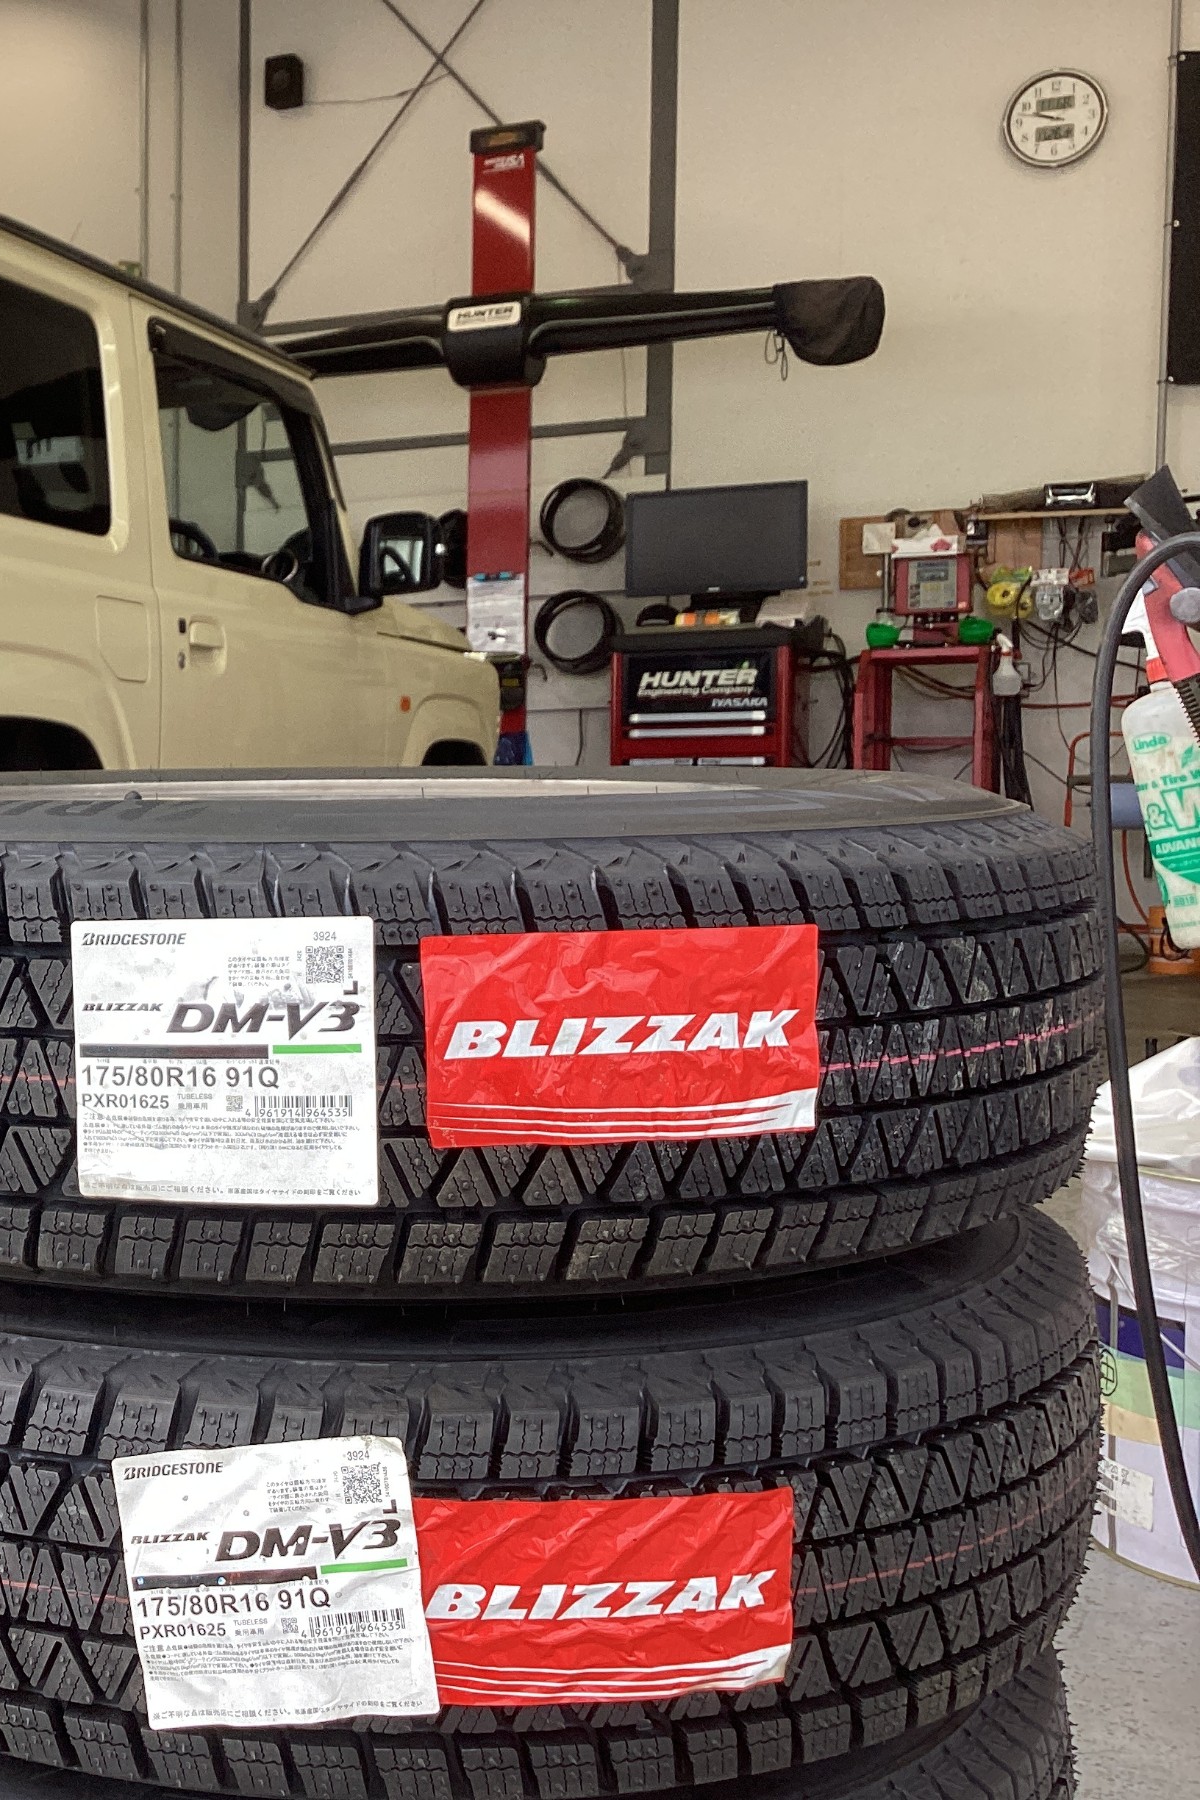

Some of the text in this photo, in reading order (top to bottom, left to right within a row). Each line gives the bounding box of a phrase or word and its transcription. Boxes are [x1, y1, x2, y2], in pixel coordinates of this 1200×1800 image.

[639, 668, 758, 688] HUNTER
[1133, 736, 1168, 751] Linda
[1160, 773, 1188, 786] Tire
[81, 932, 187, 946] BRIDGESTONE
[313, 931, 337, 941] 3924
[81, 1001, 362, 1041] BLIZZAK DM-V3
[443, 1007, 800, 1060] BLIZZAK
[81, 1064, 280, 1089] 175/80R16 91Q
[81, 1093, 170, 1110] PXR01625
[259, 1108, 301, 1118] 961914
[306, 1108, 349, 1117] 964535
[346, 1450, 370, 1461] 3924
[123, 1461, 224, 1481] BRIDGESTONE
[130, 1518, 402, 1562] BLIZZAK DM-V3
[136, 1592, 270, 1618] 175/80R16
[277, 1586, 331, 1610] 91Q
[425, 1569, 775, 1621] BLIZZAK
[139, 1622, 227, 1641] PXR01625
[314, 1624, 356, 1637] 961914
[359, 1621, 402, 1632] 964535
